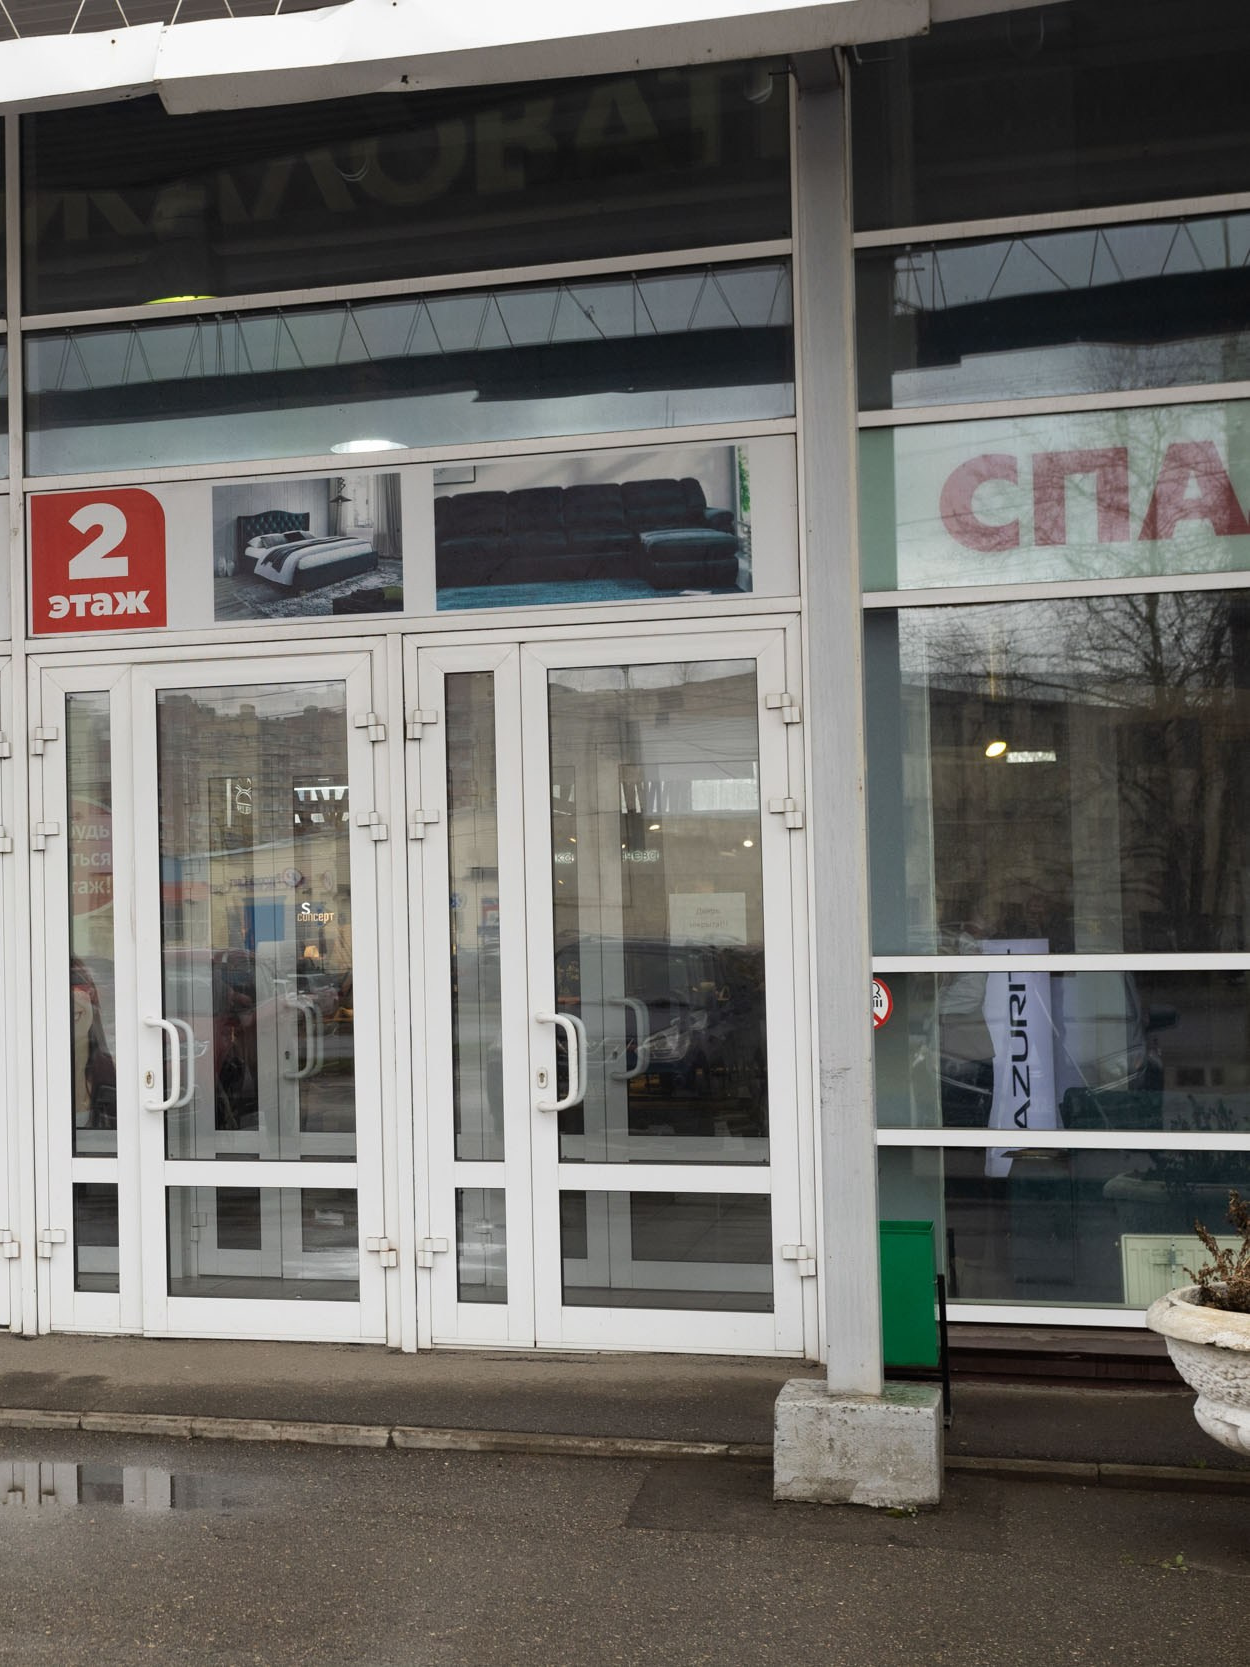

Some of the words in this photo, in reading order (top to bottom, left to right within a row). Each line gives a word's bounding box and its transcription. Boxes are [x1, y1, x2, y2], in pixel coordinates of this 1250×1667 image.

[940, 441, 1250, 553] СПА
[68, 503, 129, 580] 2
[48, 586, 150, 619] этаж
